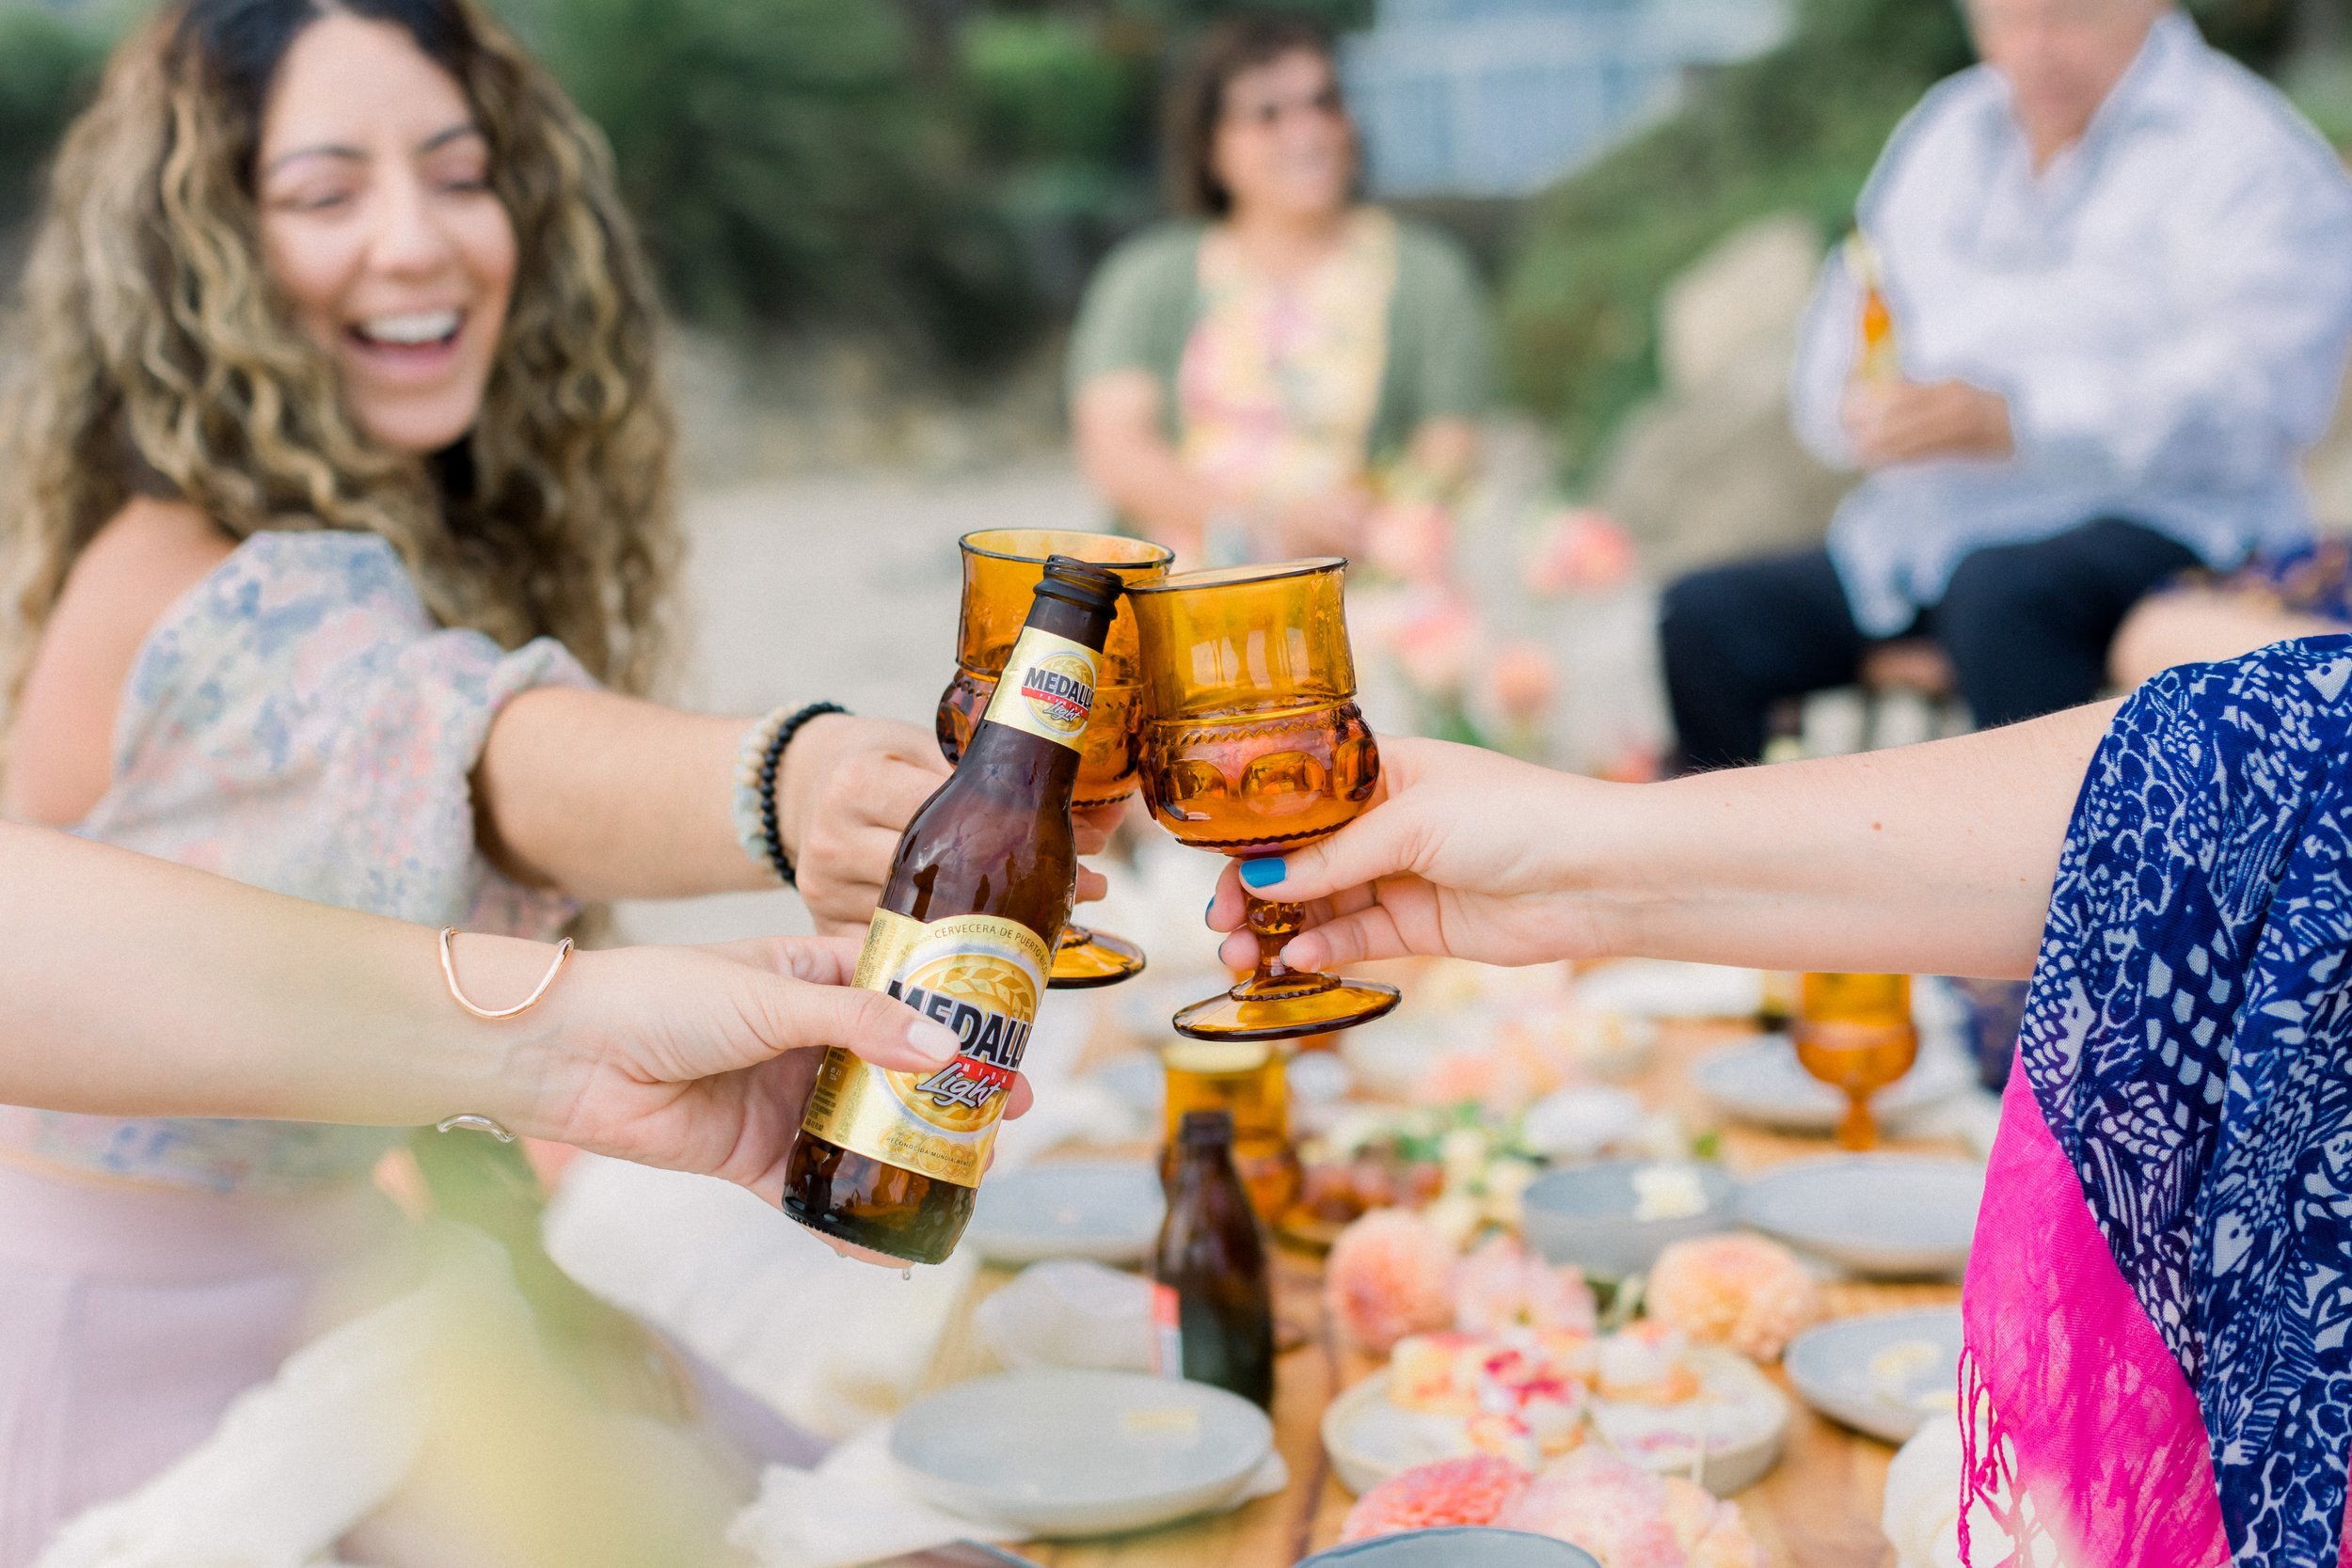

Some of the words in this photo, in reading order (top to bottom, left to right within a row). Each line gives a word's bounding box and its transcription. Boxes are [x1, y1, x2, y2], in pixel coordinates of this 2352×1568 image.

[1043, 701, 1081, 722] Light
[934, 923, 996, 939] CERVECERA
[1000, 927, 1013, 939] DE
[1015, 933, 1041, 958] PUERTO
[1039, 954, 1048, 974] RICO
[886, 978, 1033, 1069] MEDALL
[915, 1061, 1002, 1109] Light
[886, 1136, 929, 1155] RECONOCIDA
[930, 1150, 974, 1167] MUNDIALMENTE
